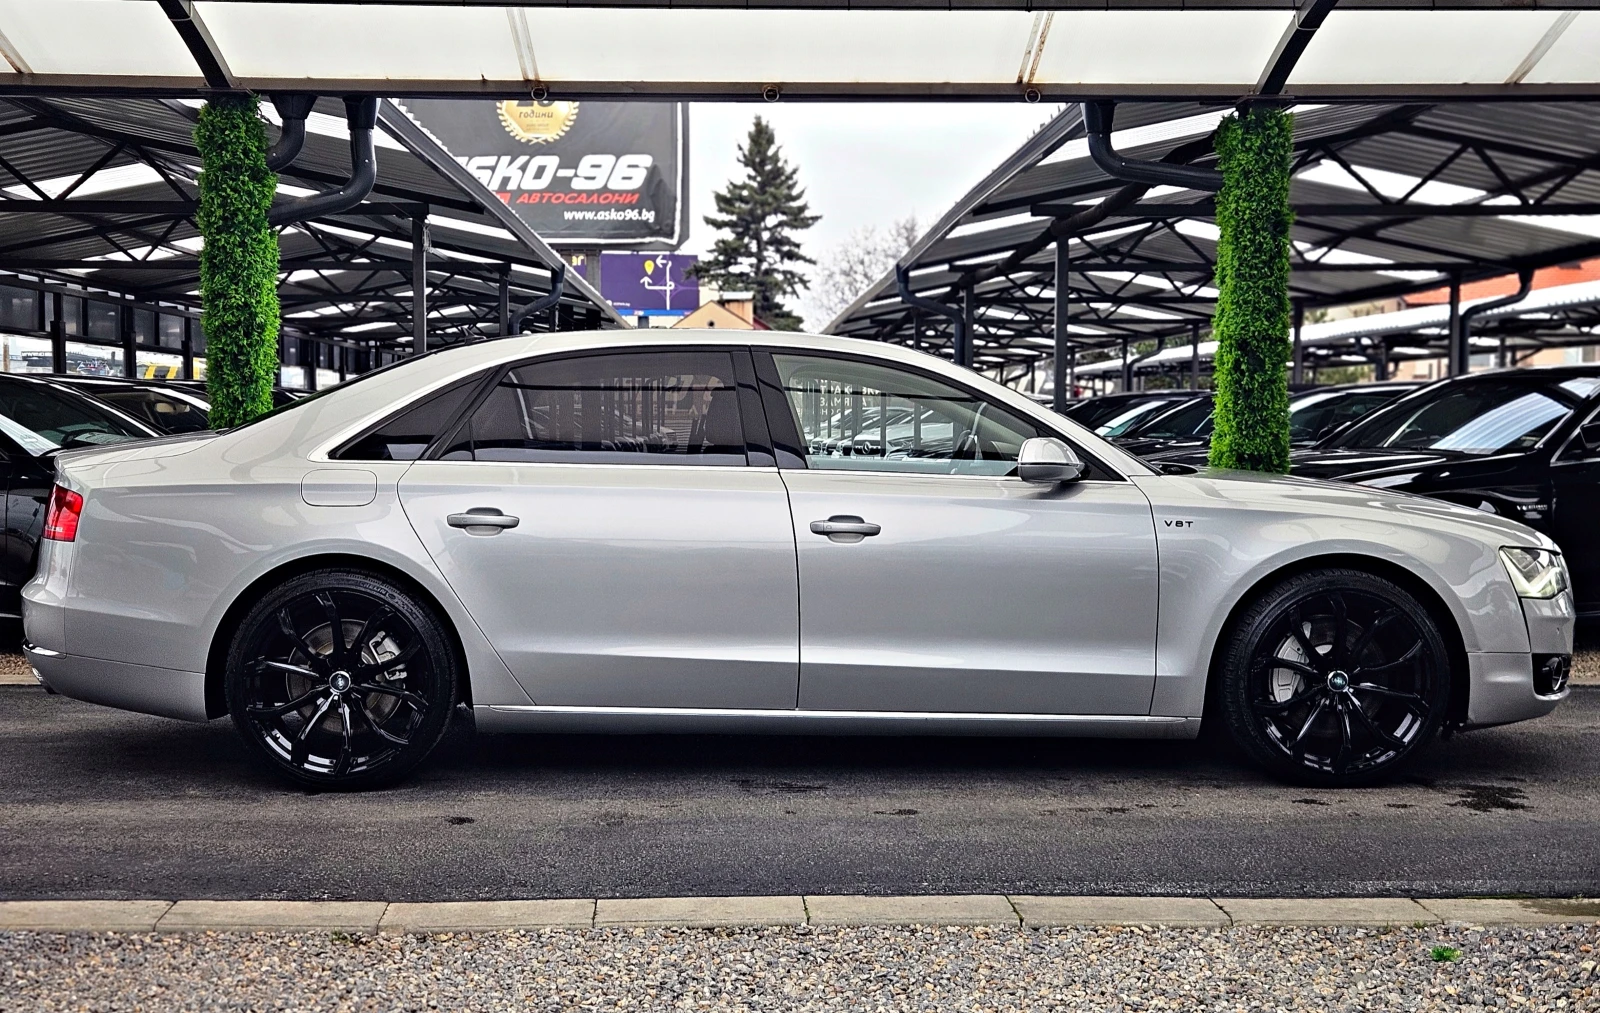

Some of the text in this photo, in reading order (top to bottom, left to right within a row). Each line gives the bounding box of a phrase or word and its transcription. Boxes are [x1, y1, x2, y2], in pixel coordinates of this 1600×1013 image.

[519, 109, 554, 119] години
[516, 192, 640, 205] АВТОСАЛОНИ
[563, 207, 655, 223] www.asko96.bg
[1163, 519, 1194, 528] V8T
